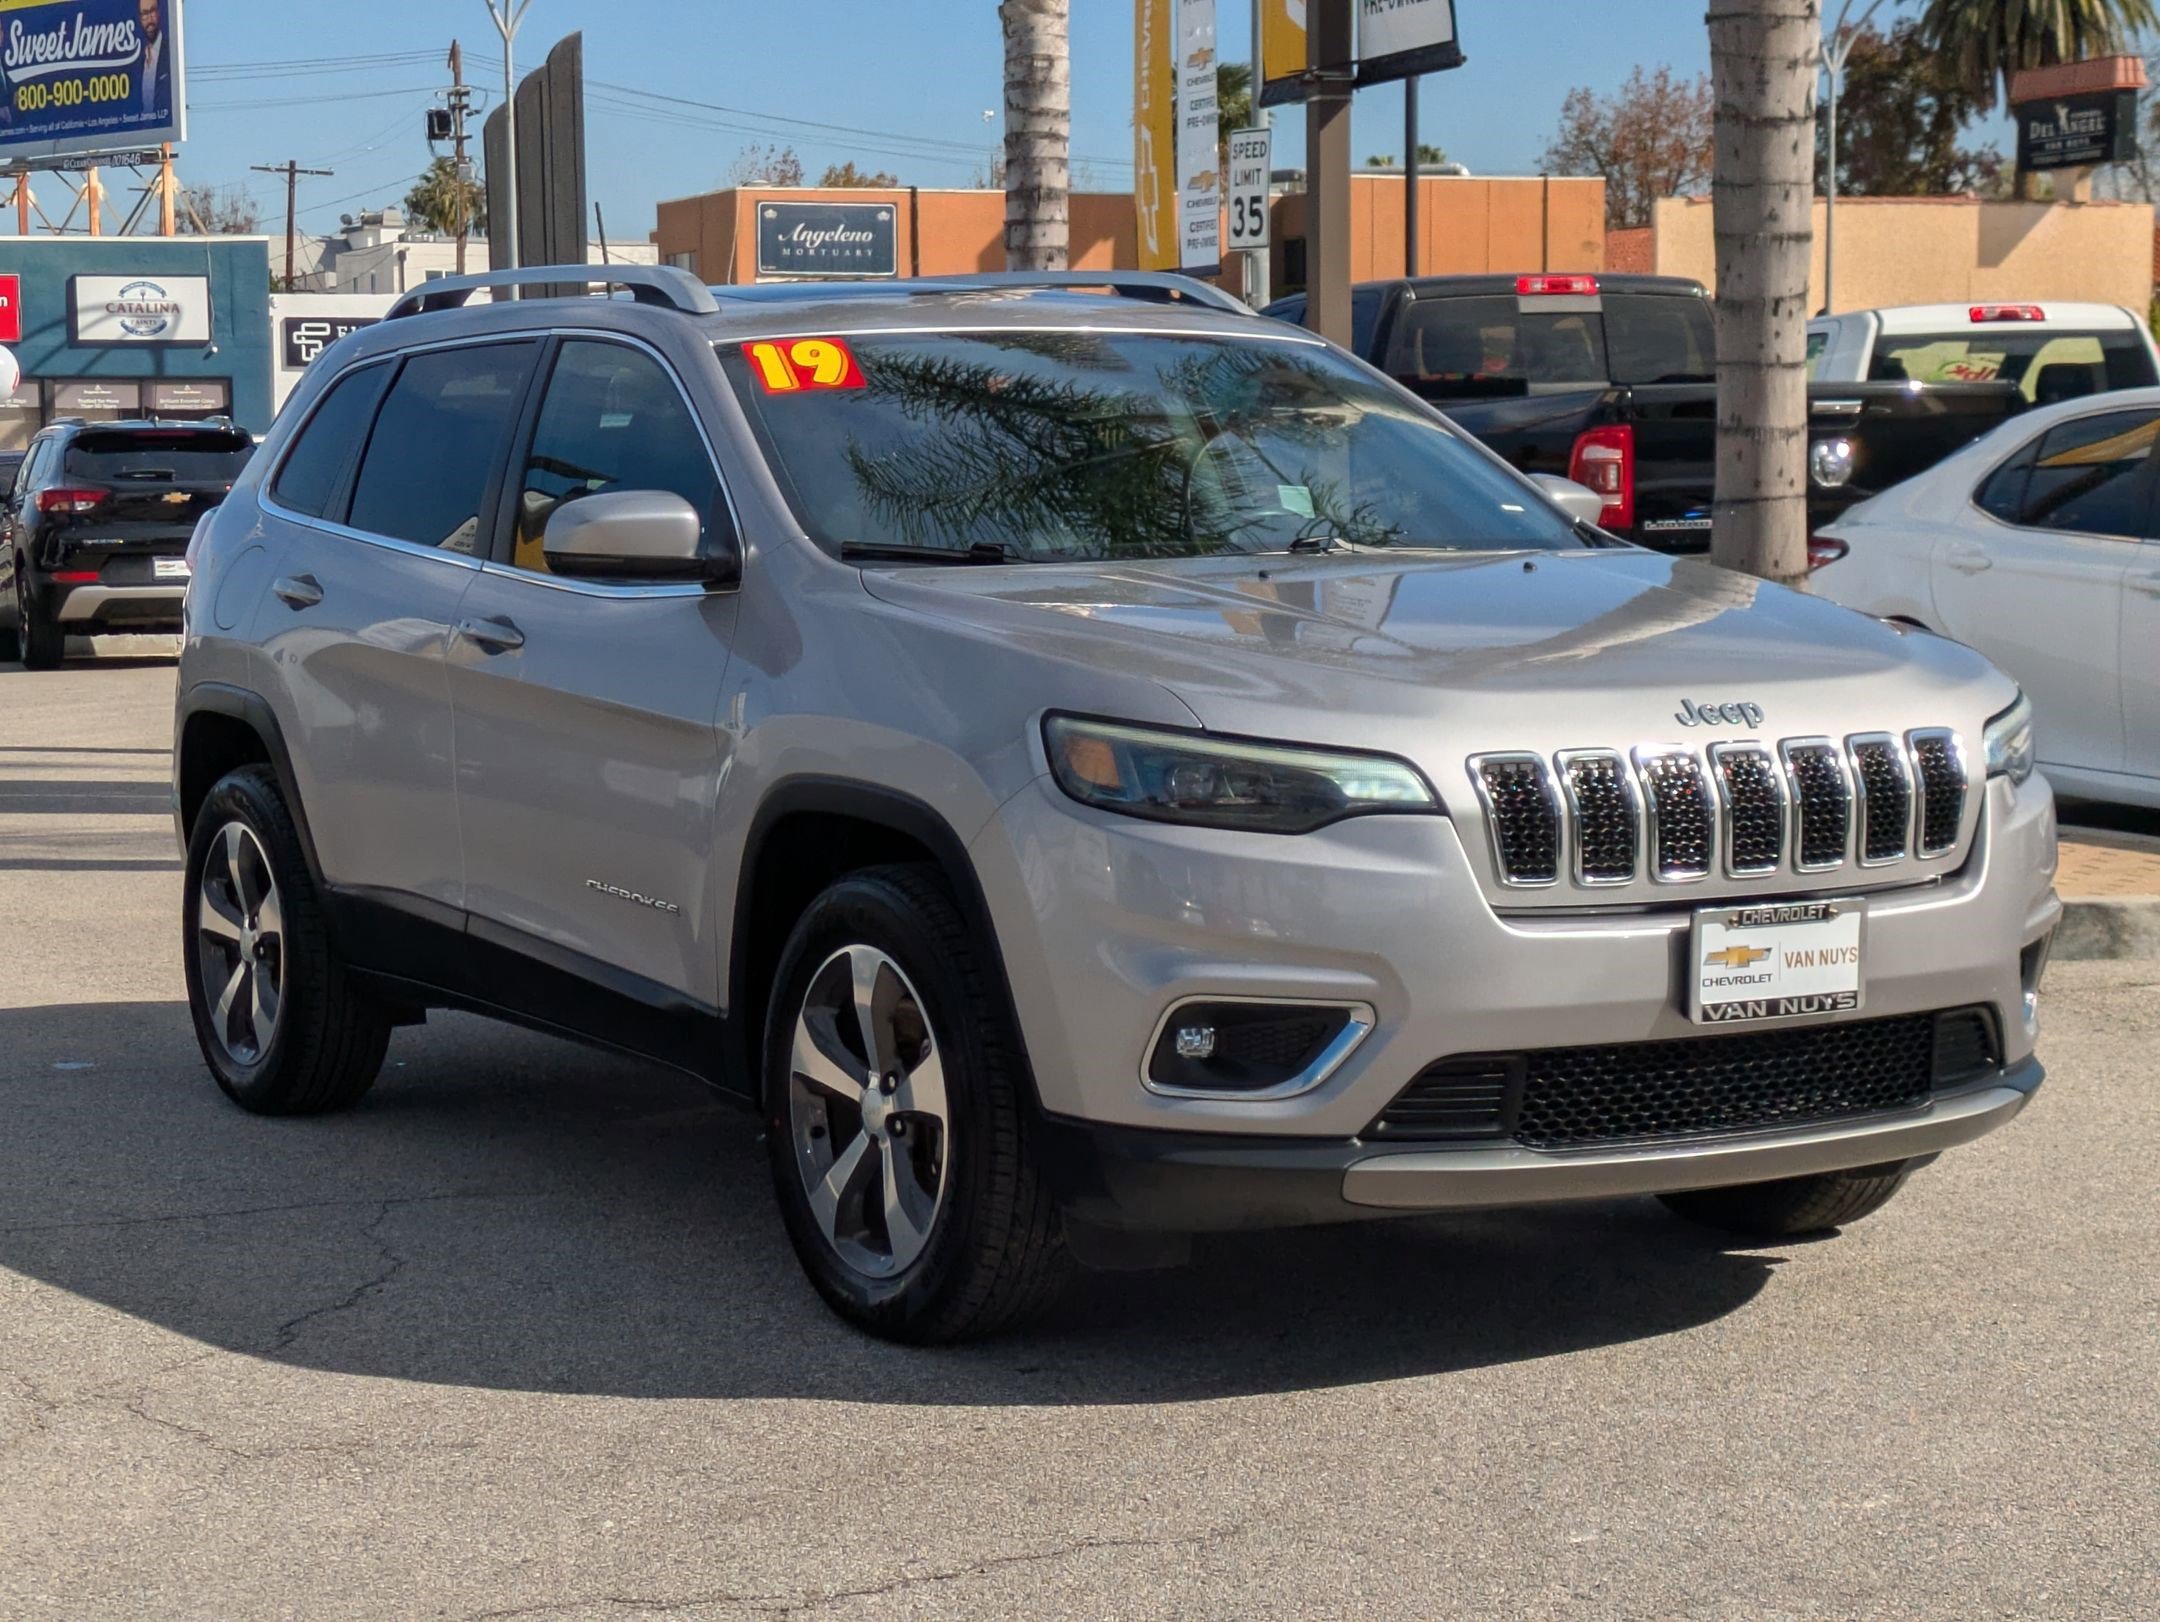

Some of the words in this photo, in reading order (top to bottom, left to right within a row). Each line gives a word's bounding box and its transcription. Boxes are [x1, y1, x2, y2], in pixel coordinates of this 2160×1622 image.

[17, 74, 130, 111] 800-900-0000
[1232, 141, 1267, 160] SPEED
[1234, 168, 1262, 187] LIMIT
[1232, 195, 1264, 238] 35
[778, 222, 873, 248] Angeleno
[782, 247, 873, 257] MORTUARY
[105, 302, 180, 314] CATALINA
[752, 340, 849, 389] 19
[1674, 699, 1764, 729] Jeep
[1742, 904, 1827, 925] CHEVROLET
[1784, 950, 1814, 969] VAN
[1819, 946, 1858, 966] NUYS
[1702, 973, 1774, 988] CHEVROLET
[1704, 1000, 1768, 1021] VAN
[1779, 992, 1856, 1016] NUYS
